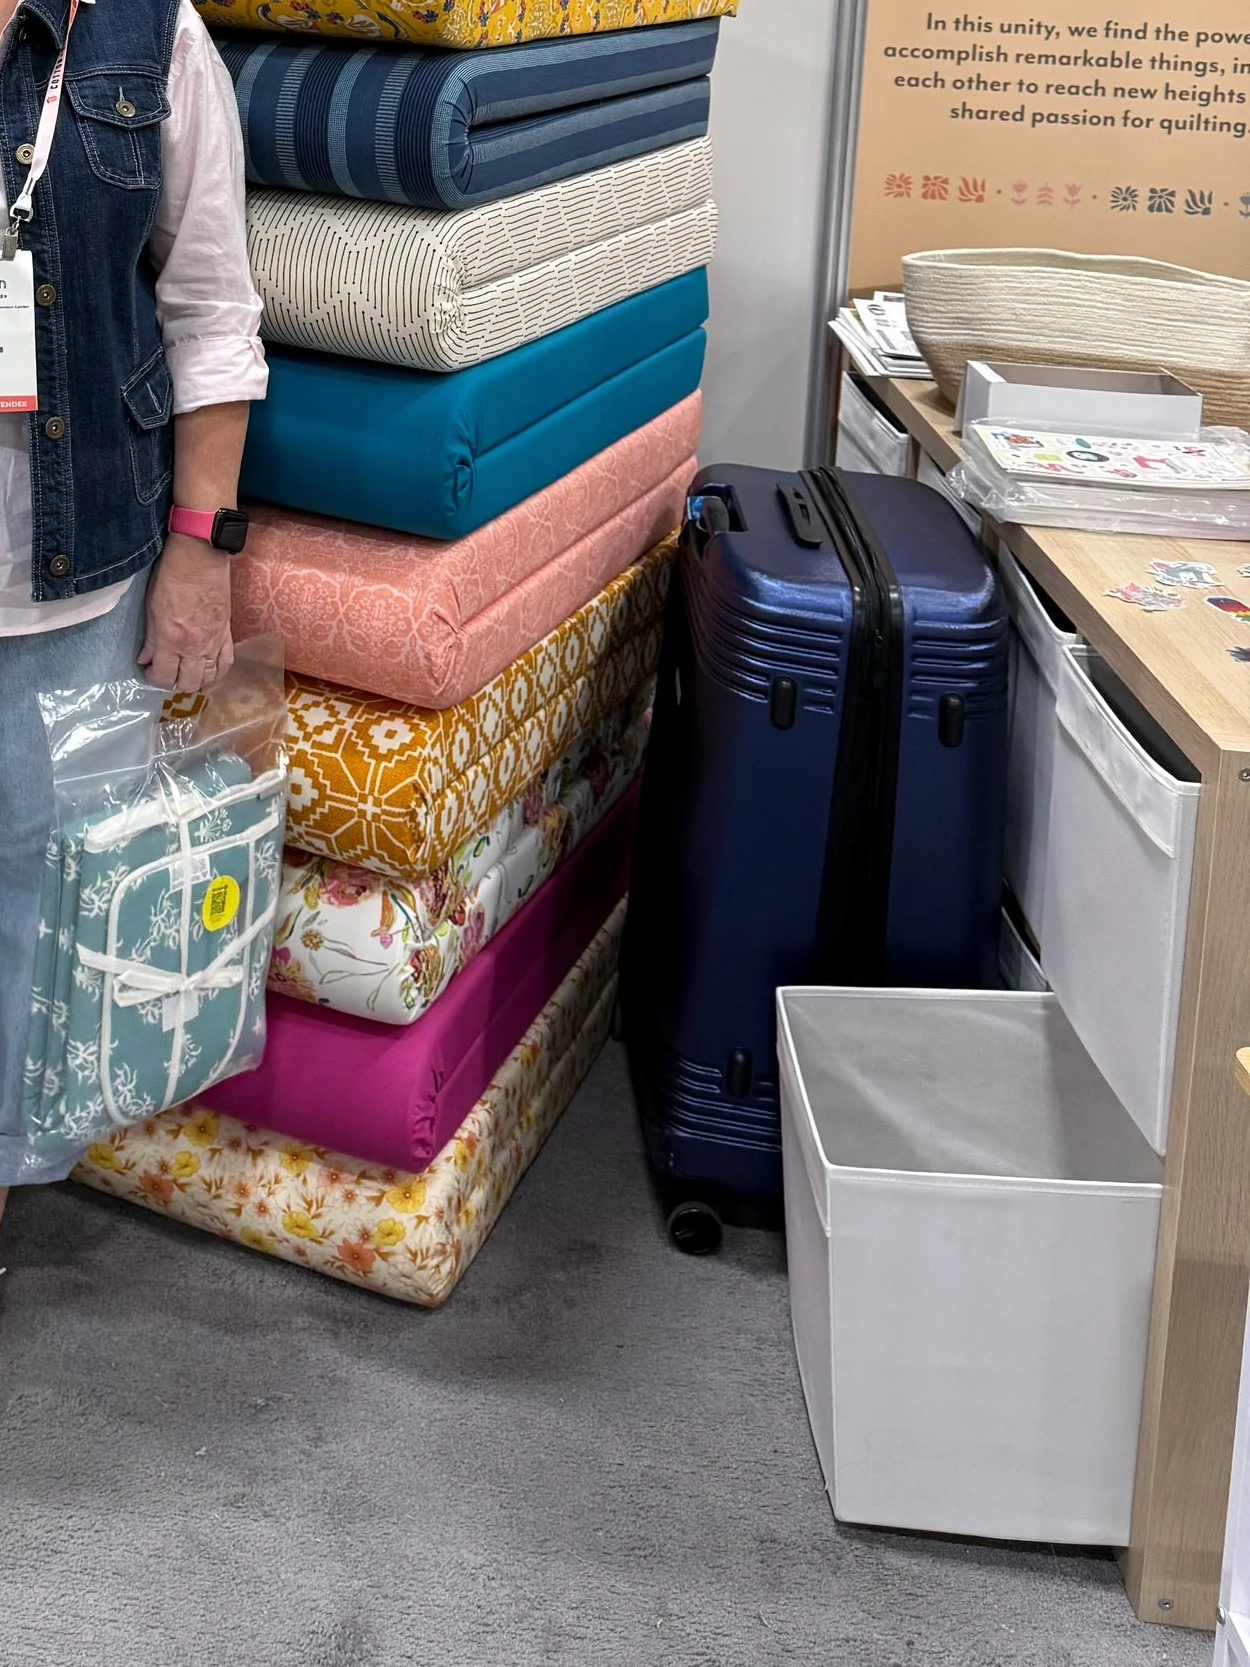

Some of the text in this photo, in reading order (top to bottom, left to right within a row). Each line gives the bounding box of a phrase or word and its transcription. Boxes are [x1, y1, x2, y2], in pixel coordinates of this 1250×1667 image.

[927, 13, 946, 31] In
[953, 14, 993, 34] this
[1000, 18, 1060, 41] unity,
[1068, 26, 1098, 38] we
[1104, 20, 1148, 40] find
[1154, 23, 1189, 42] the
[884, 44, 1008, 67] accomplish
[1015, 49, 1143, 70] remarkable
[1149, 52, 1225, 77] things,
[894, 71, 1246, 107] each other to reach new heights
[950, 101, 1025, 123] shared
[1031, 109, 1115, 129] passion
[1122, 110, 1154, 129] for
